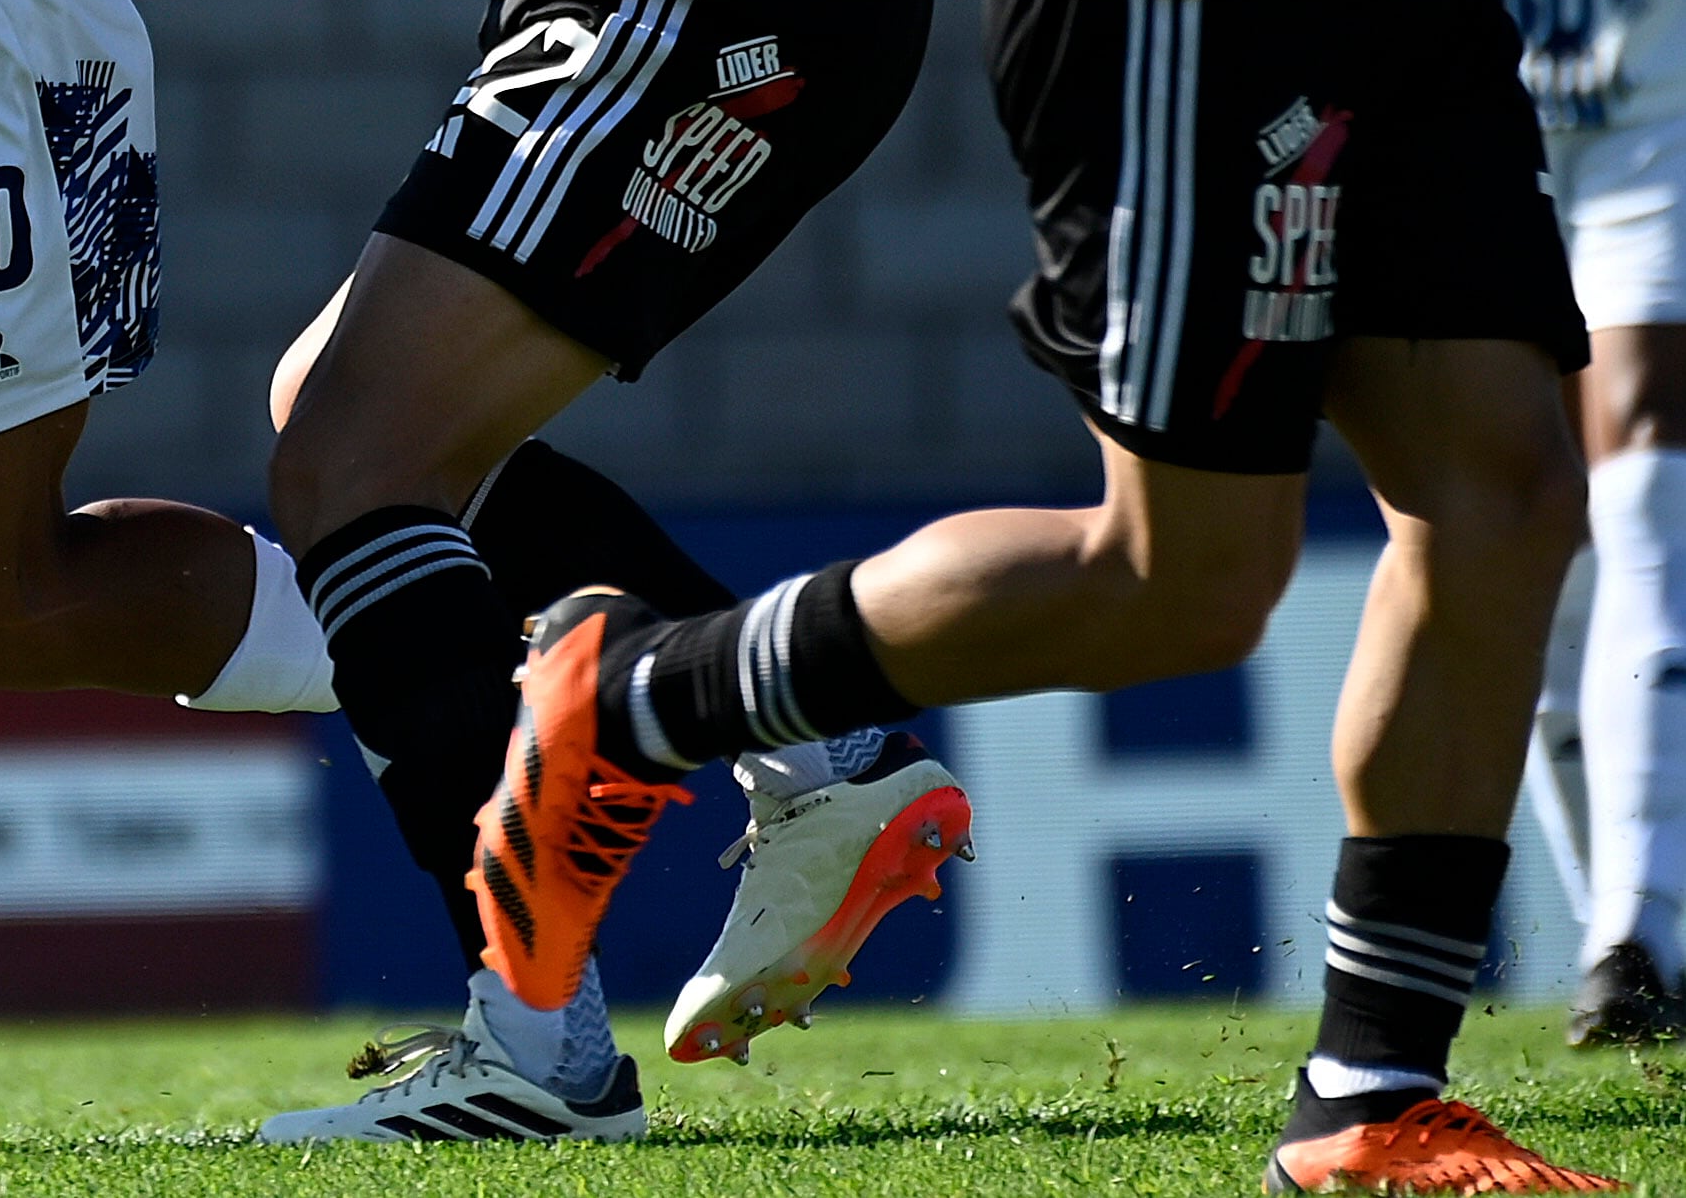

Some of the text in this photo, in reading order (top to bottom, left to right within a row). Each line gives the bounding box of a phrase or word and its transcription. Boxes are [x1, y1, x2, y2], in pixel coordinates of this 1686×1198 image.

[716, 42, 780, 90] LIDER
[642, 101, 773, 215] SPEED
[621, 165, 719, 254] UNLIMITED
